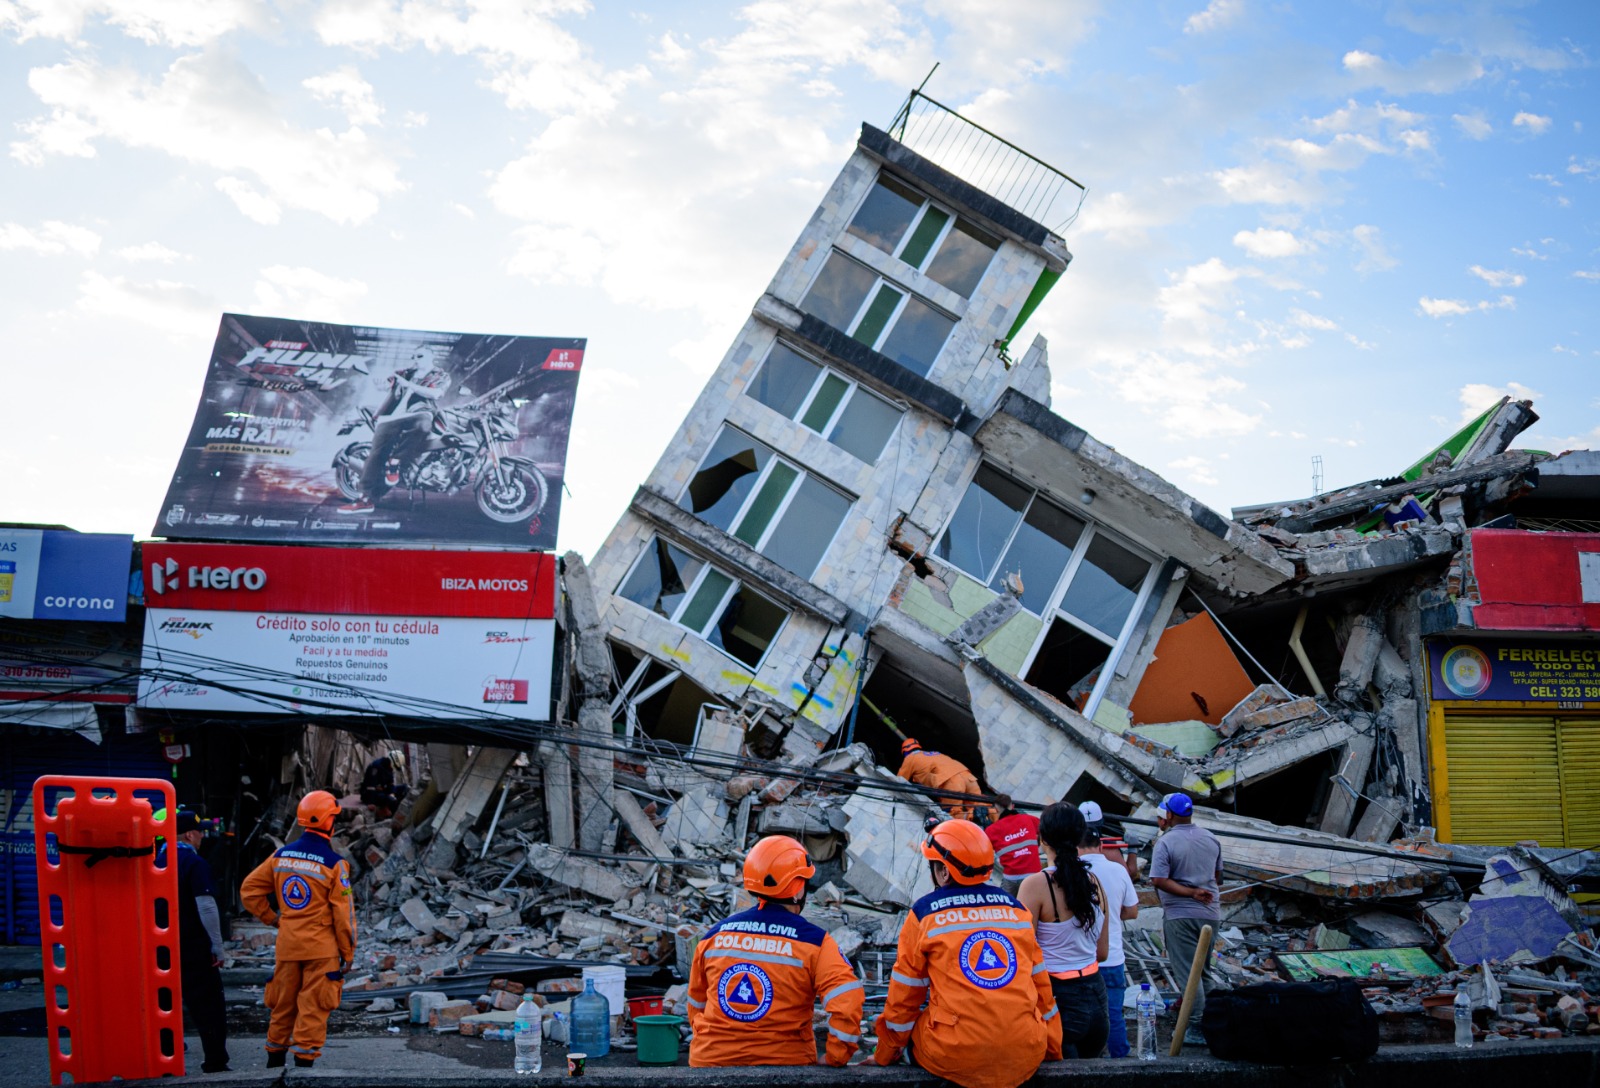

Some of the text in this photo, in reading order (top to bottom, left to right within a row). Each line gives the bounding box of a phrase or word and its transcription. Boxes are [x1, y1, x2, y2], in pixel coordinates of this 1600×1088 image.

[236, 347, 373, 375] HUNK
[550, 360, 575, 369] Hero
[247, 415, 306, 428] DEPORTIVA
[206, 425, 241, 438] MÁS
[0, 542, 17, 552] AS
[188, 566, 267, 590] Hero
[441, 578, 528, 591] IBIZA MOTOS
[44, 596, 115, 610] corona
[159, 621, 214, 631] HUNK
[256, 615, 439, 635] Crédito solo con tu cédula
[289, 633, 341, 644] Aprobación
[343, 636, 354, 644] en
[373, 636, 410, 646] minutos
[327, 648, 333, 657] y
[343, 648, 352, 656] tu
[354, 648, 388, 657] medida
[295, 657, 389, 670] Repuestos Genuinos
[1533, 662, 1572, 670] TODO
[301, 670, 388, 682] Taller especializado
[1530, 686, 1600, 698] CEL: 323 58
[281, 850, 325, 864] DEFENSA CIVIL
[278, 859, 321, 873] COLOMBIA
[930, 894, 1014, 911] DEFENSA CIVIL
[934, 908, 1019, 925] COLOMBIA
[719, 921, 799, 938] DEFENSA CIVIL
[714, 935, 793, 956] COLOMBIA
[961, 931, 1015, 968] DEFENSA CIVIL COLOMBIANA
[718, 964, 772, 1002] DEFENSA CIVIL COLOMBIANA
